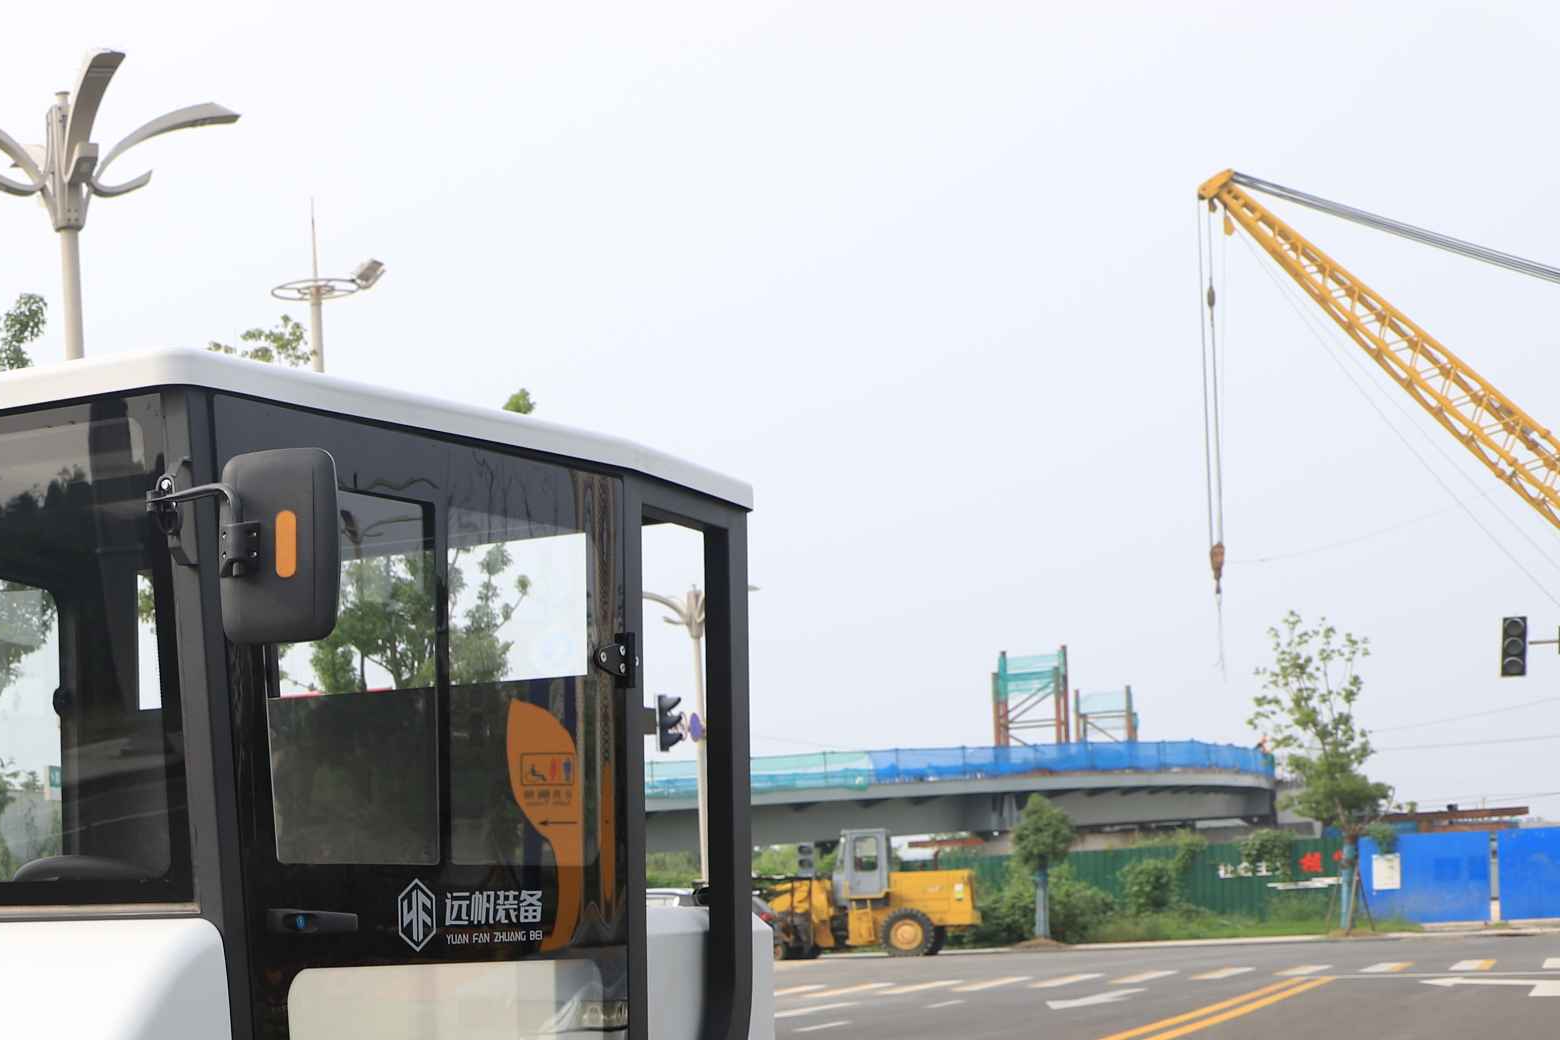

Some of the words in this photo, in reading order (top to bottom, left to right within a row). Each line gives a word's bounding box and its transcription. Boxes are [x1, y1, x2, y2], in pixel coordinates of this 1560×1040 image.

[445, 890, 543, 926] 远帆装备
[446, 933, 469, 945] YUAN
[472, 932, 490, 944] FAN
[494, 930, 526, 943] ZHUANG
[529, 930, 543, 941] BEI
